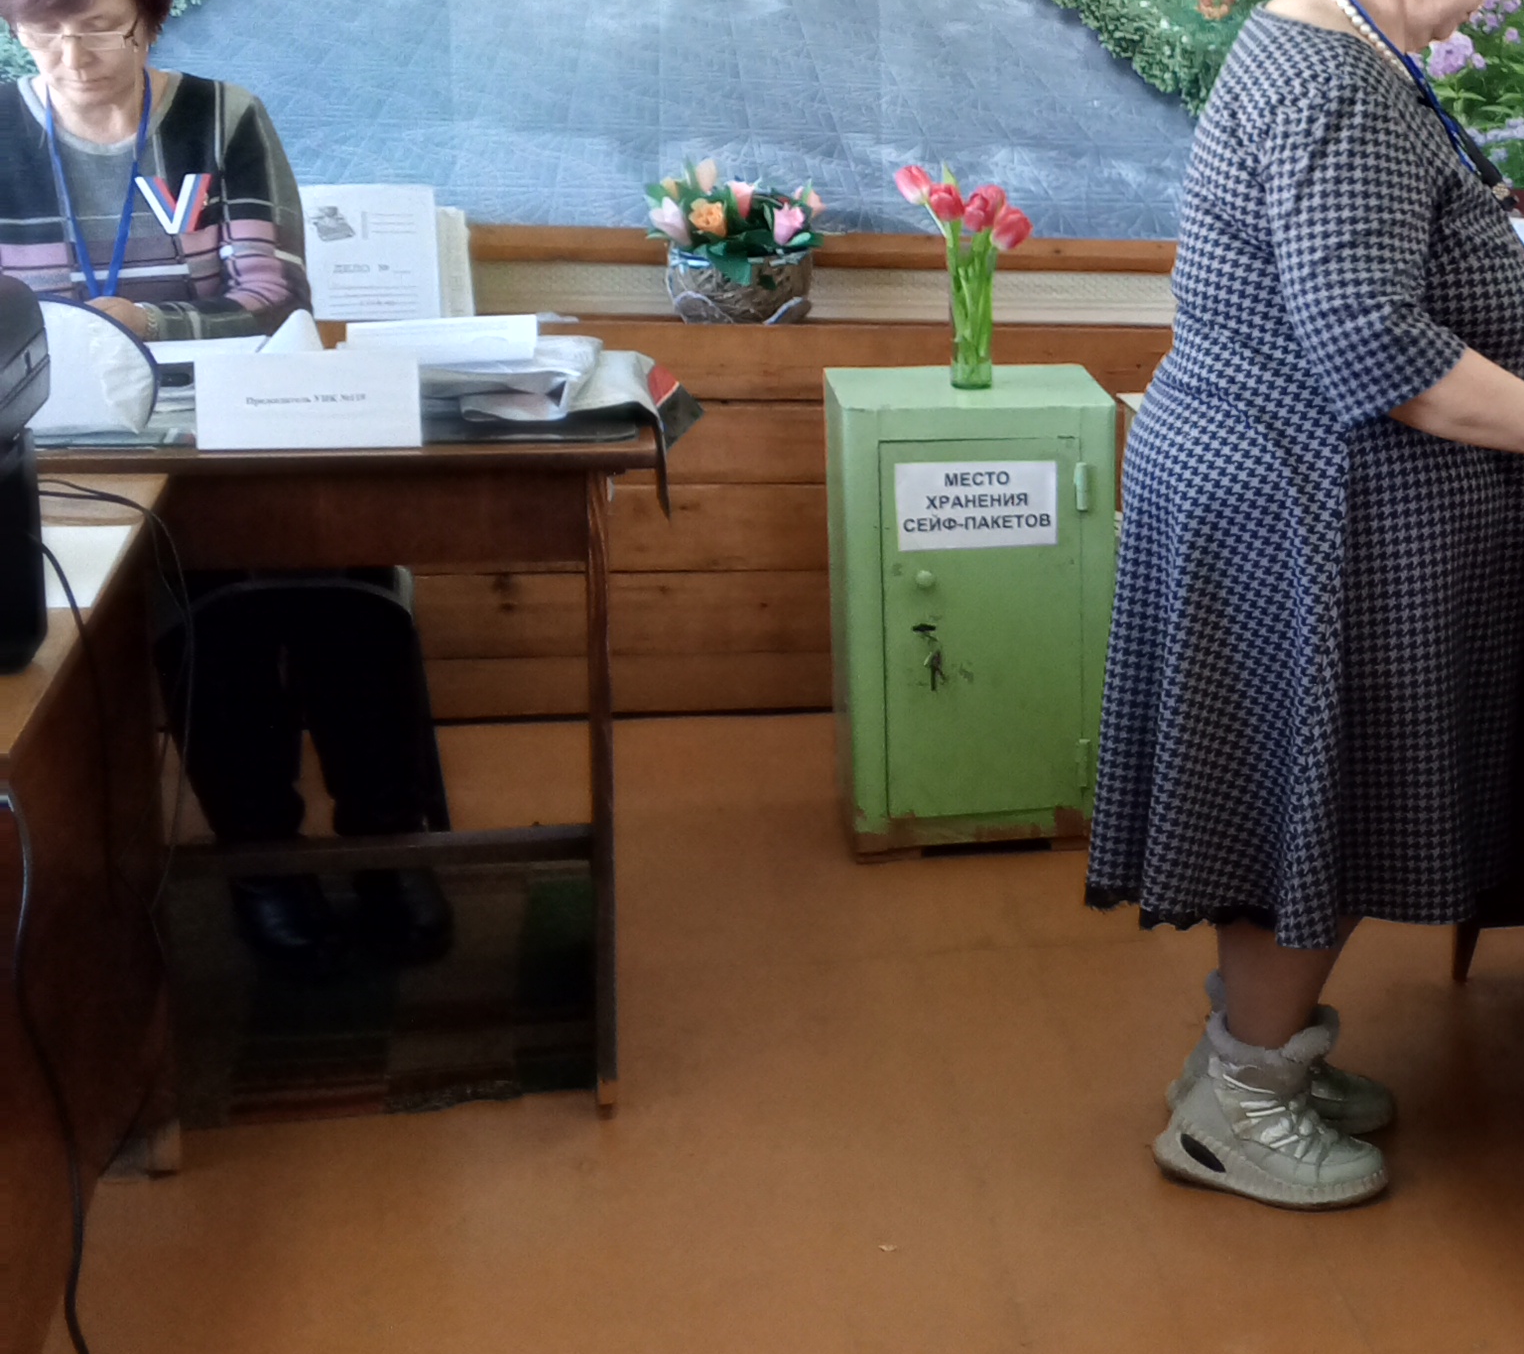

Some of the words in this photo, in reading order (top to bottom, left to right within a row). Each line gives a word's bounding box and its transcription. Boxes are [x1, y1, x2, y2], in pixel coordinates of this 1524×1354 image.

[944, 471, 1010, 487] МЕСТО
[926, 492, 1029, 509] ХРАНЕНИЯ
[903, 512, 1051, 533] СЕЙФ-ПАКЕТОВ
